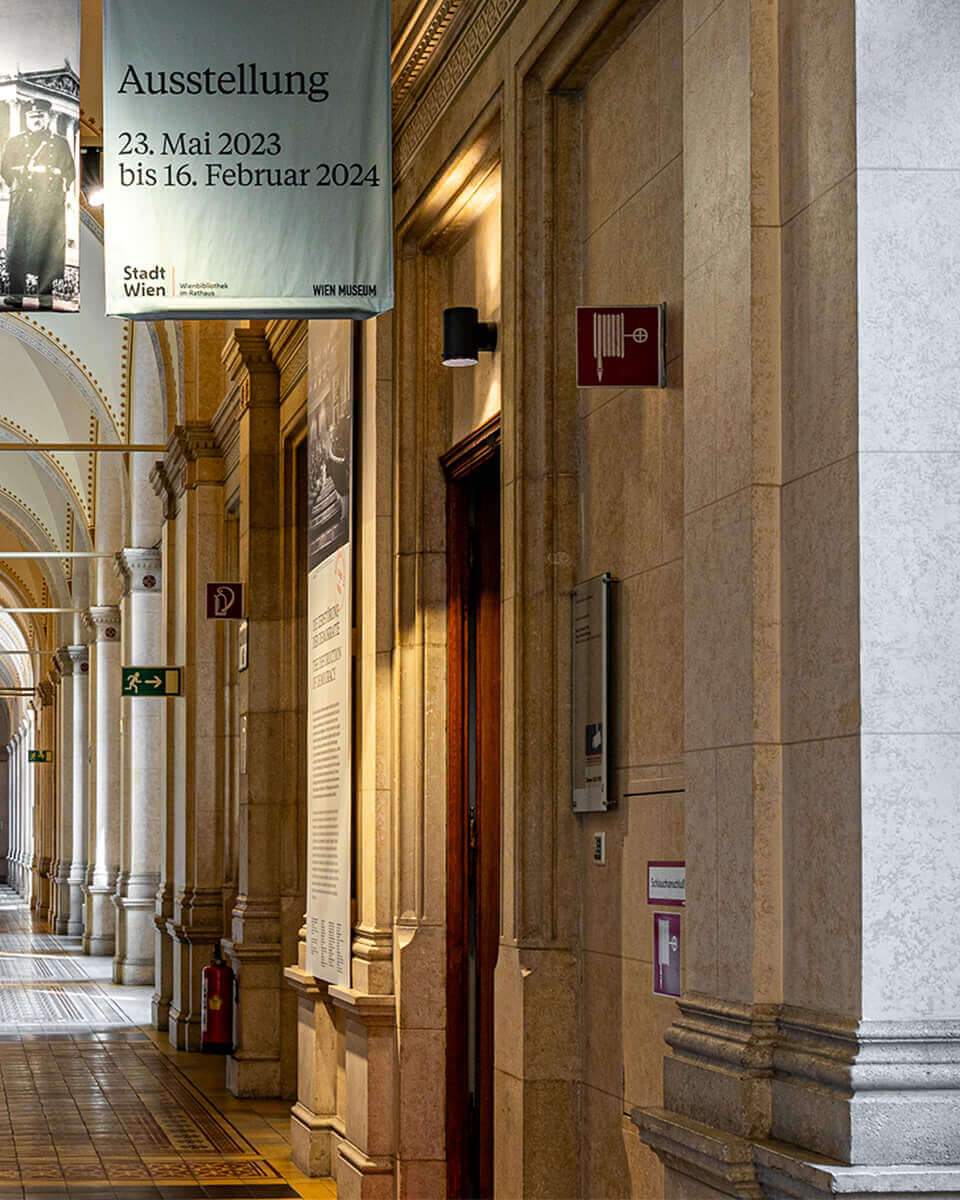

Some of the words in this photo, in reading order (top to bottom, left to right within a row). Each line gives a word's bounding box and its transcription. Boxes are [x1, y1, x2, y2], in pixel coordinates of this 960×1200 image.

[118, 63, 328, 102] Ausstellung
[119, 132, 154, 155] 23.
[160, 132, 211, 155] Mai
[218, 133, 281, 155] 2023
[119, 162, 157, 186] bis
[164, 164, 197, 186] 16.
[205, 164, 310, 186] Februar
[316, 163, 380, 187] 2024
[124, 265, 166, 280] Stadt
[124, 283, 165, 297] Wien
[313, 284, 336, 296] WIEN
[339, 284, 376, 296] MUSEUM
